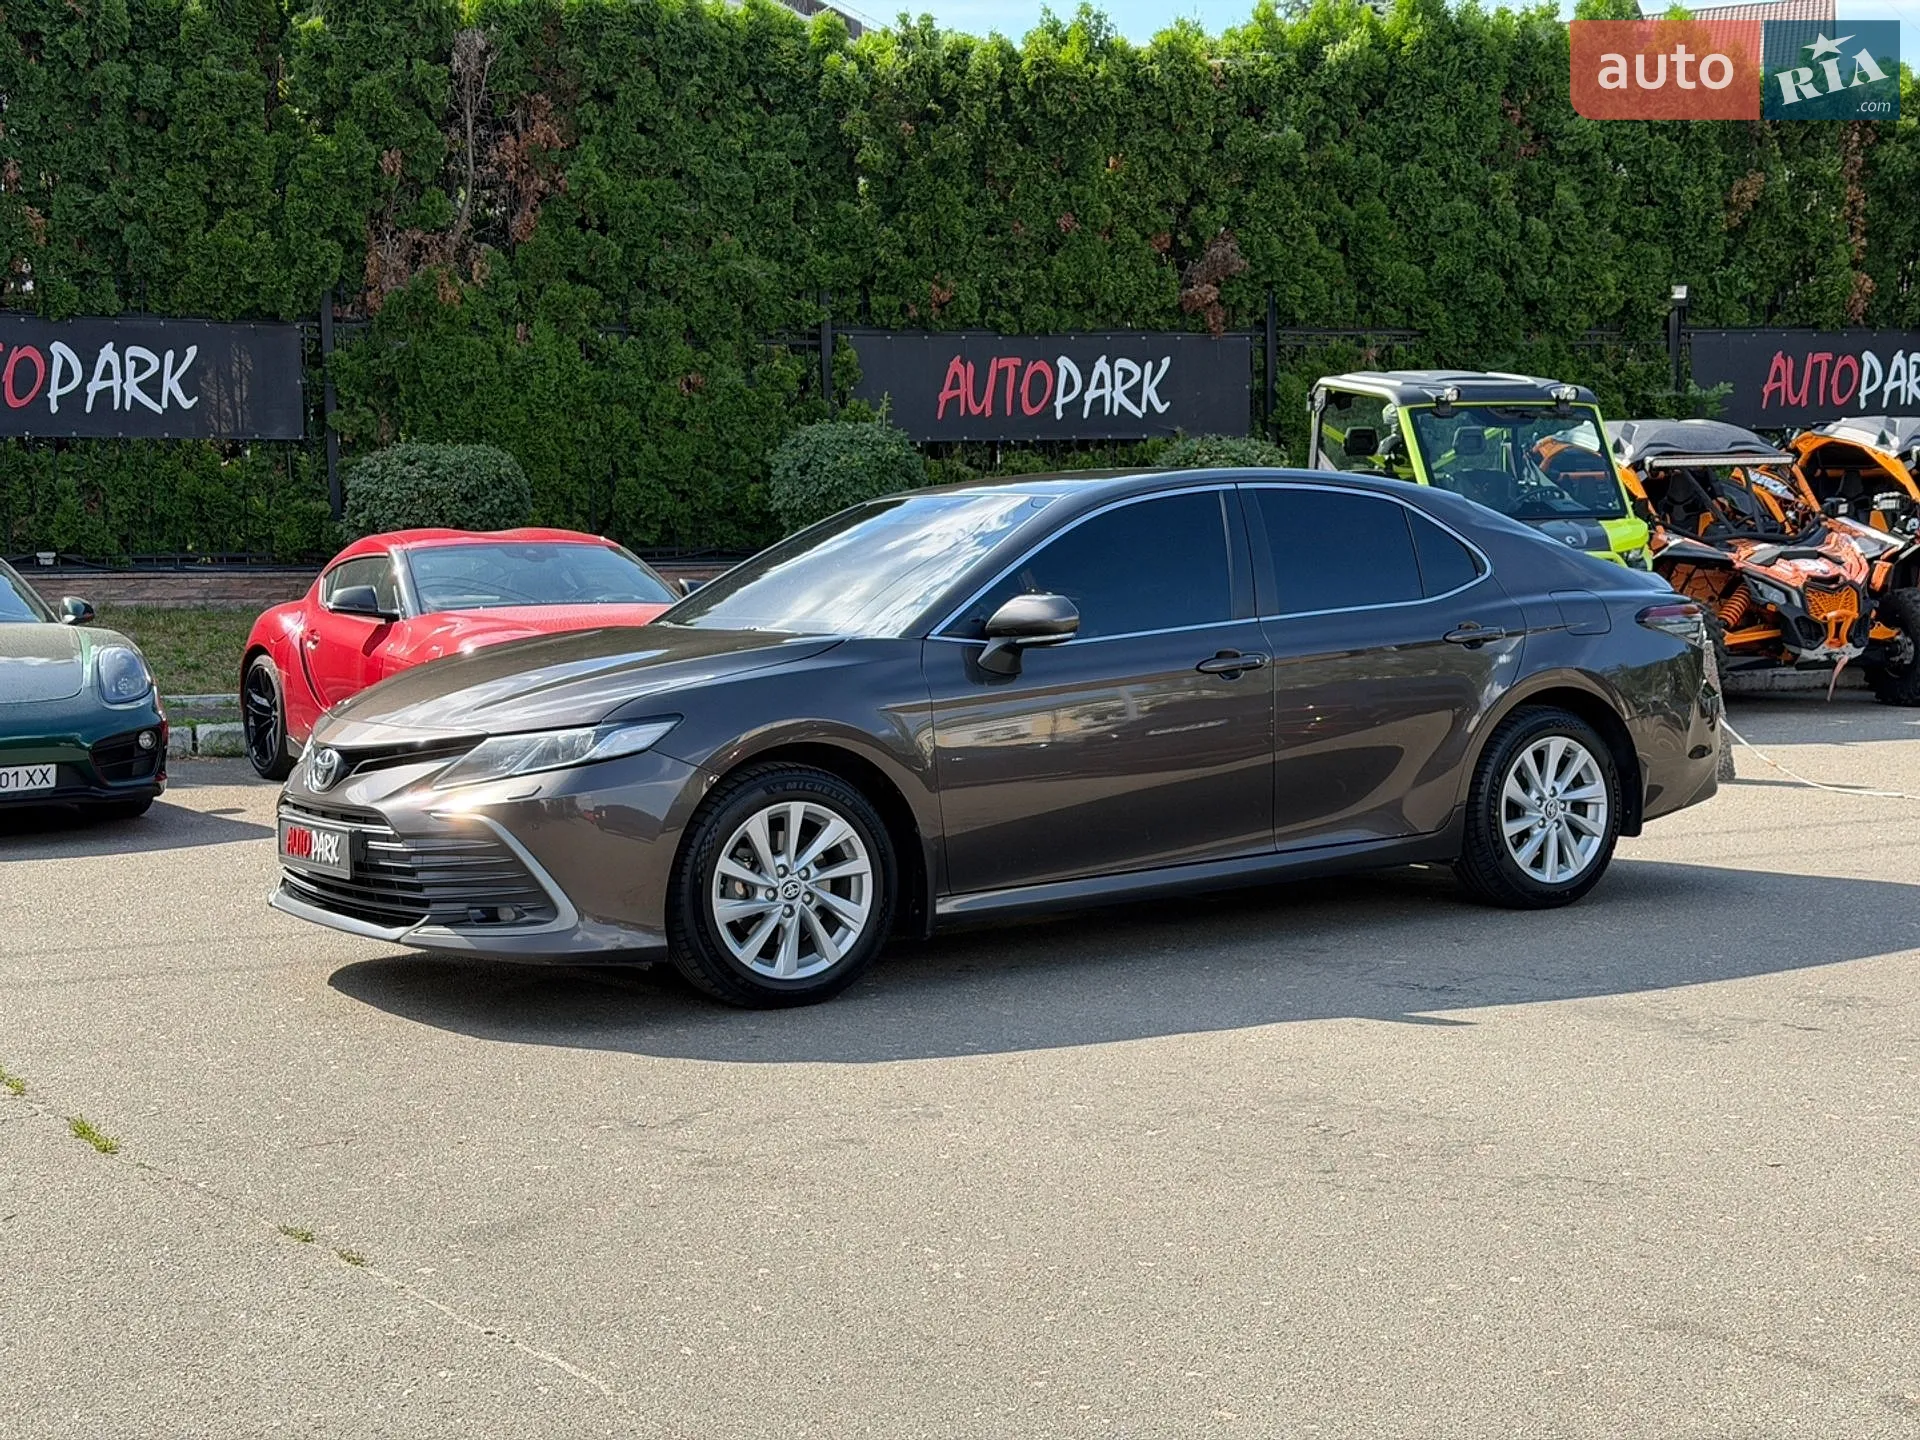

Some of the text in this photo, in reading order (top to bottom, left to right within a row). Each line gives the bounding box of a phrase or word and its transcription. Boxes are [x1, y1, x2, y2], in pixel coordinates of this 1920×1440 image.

[0, 340, 199, 415] OPARK
[937, 355, 1171, 420] AUTOPARK
[25, 767, 51, 787] XX
[786, 781, 853, 807] MICHELIN
